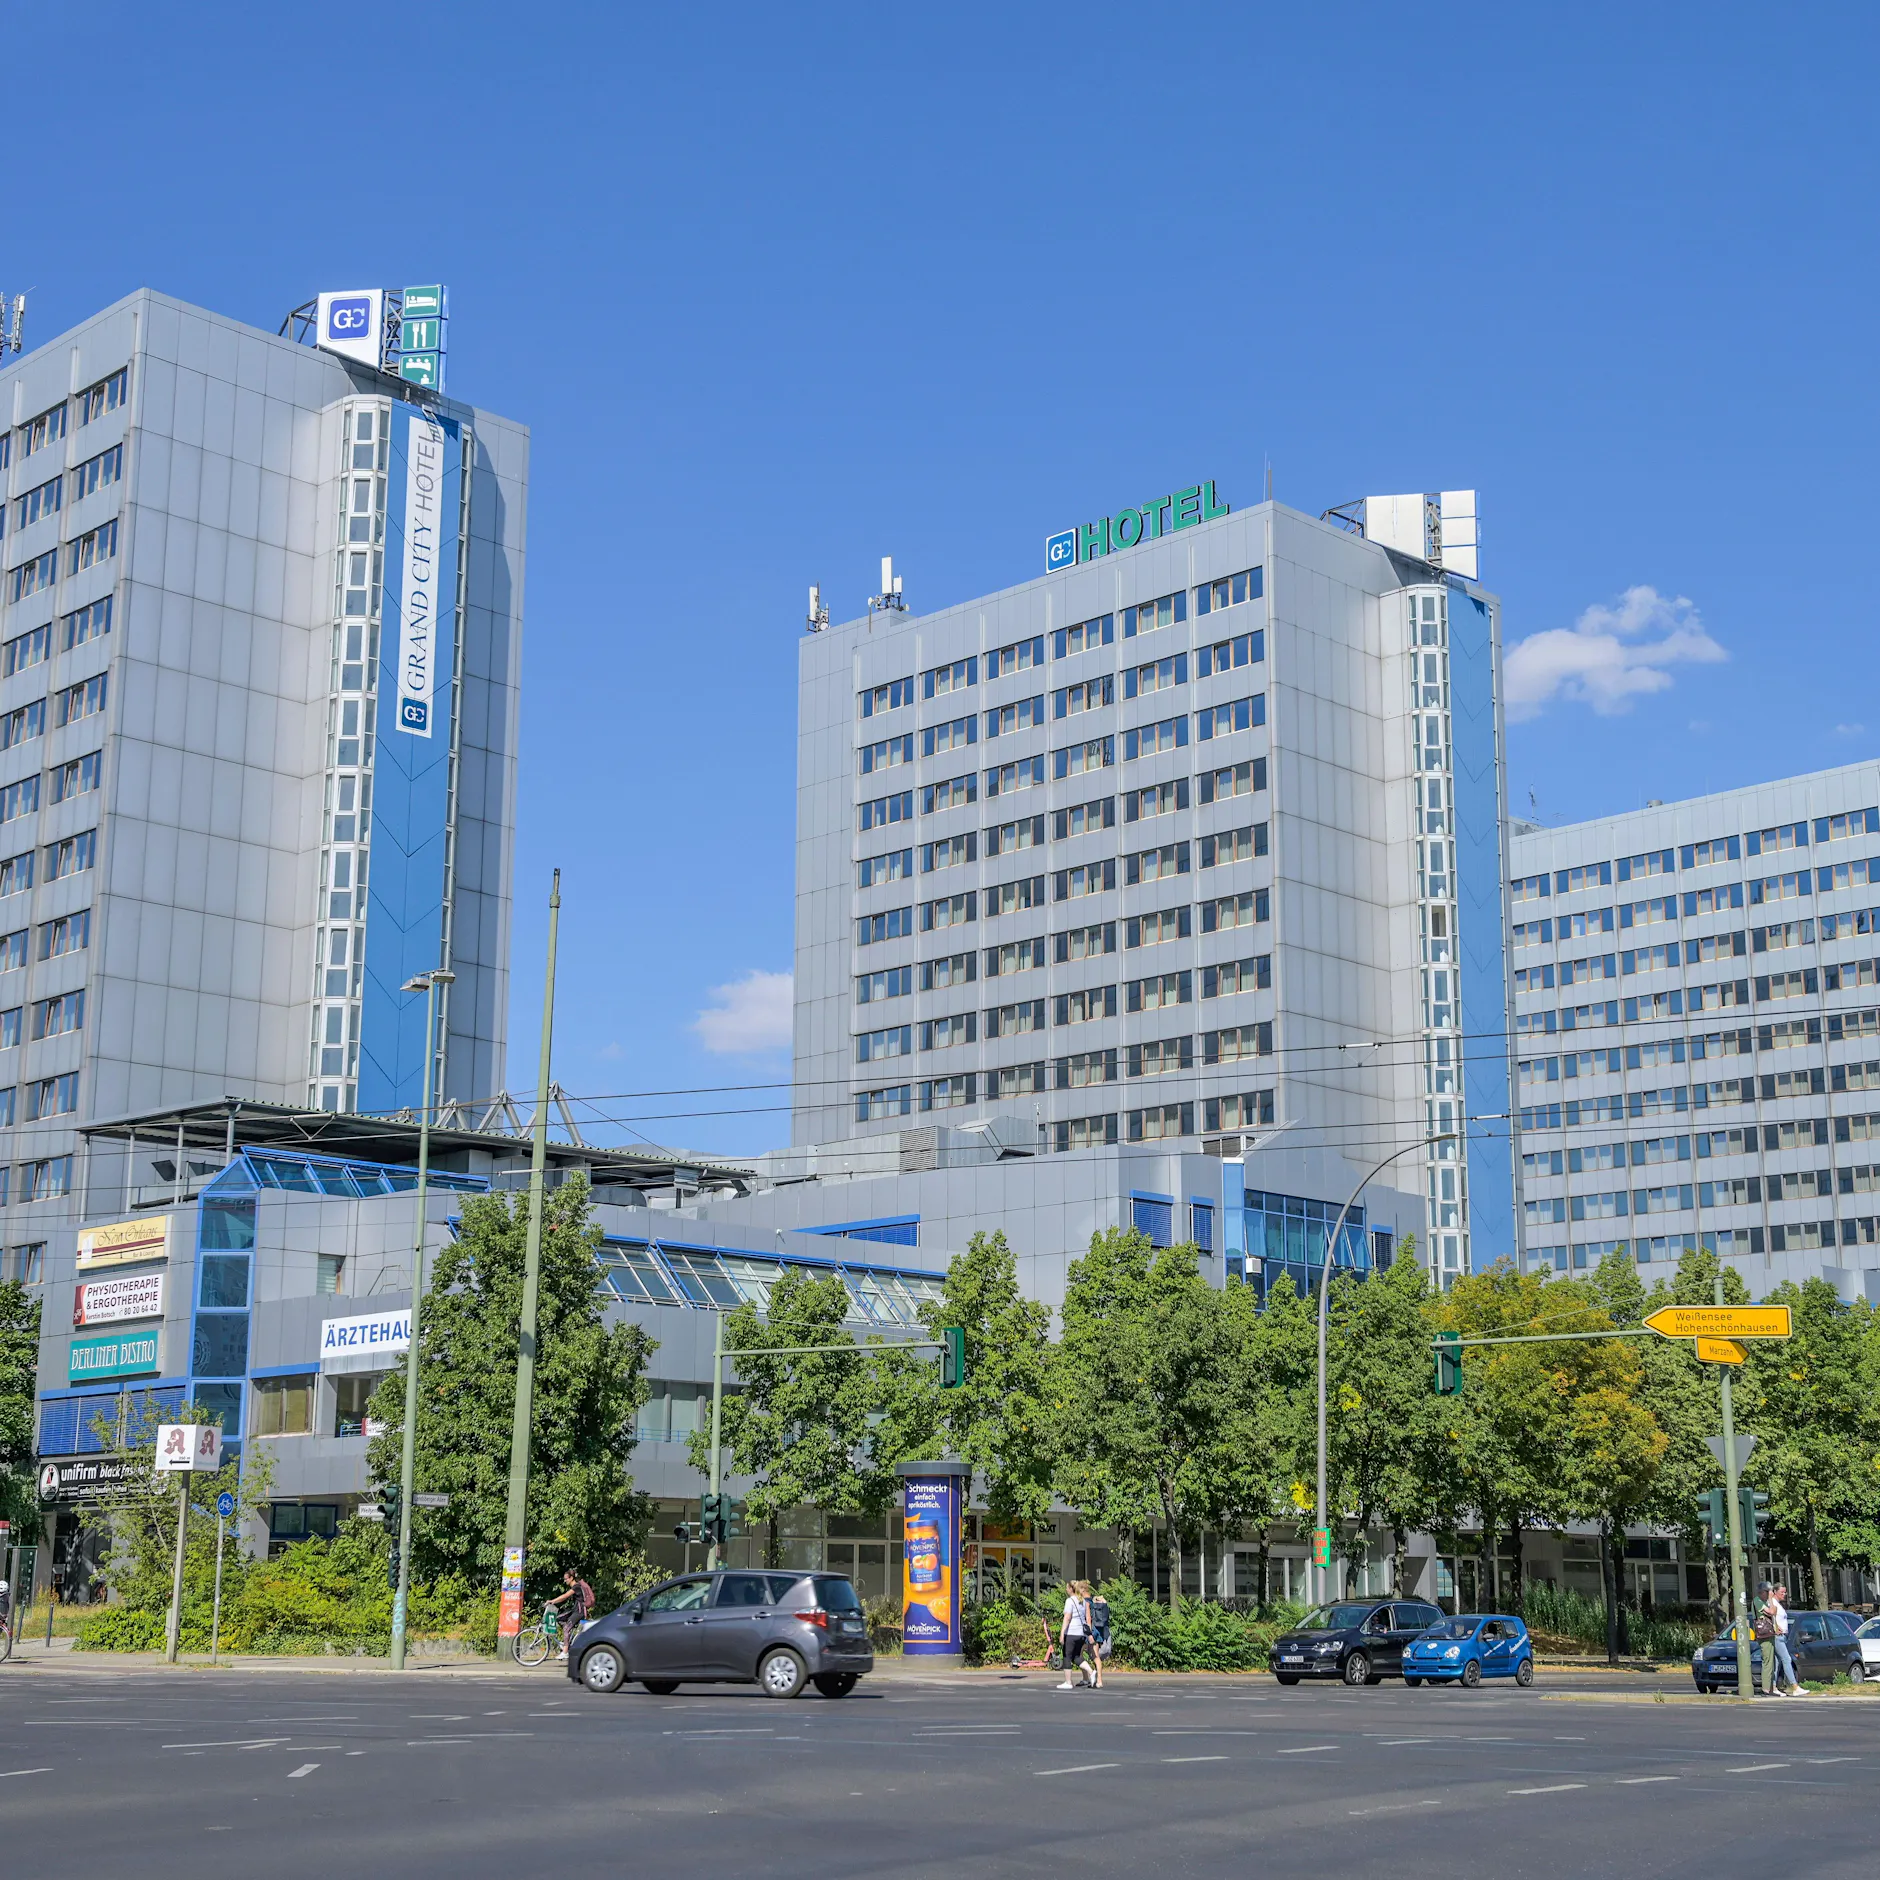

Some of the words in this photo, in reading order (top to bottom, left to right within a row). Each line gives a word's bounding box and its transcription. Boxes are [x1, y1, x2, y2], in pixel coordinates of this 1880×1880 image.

[415, 434, 437, 512] HOTEL
[1079, 480, 1230, 564] HOTEL
[411, 516, 432, 583] CITY
[407, 590, 429, 692] GRAND
[97, 1228, 123, 1246] New
[125, 1224, 158, 1242] Orleans
[87, 1277, 159, 1297] PHYSIOTHERAPIE
[86, 1301, 92, 1310] &
[93, 1291, 158, 1309] ERGOTHERAPIE
[124, 1308, 131, 1316] 80
[132, 1306, 140, 1314] 20
[141, 1305, 148, 1313] 64
[150, 1303, 158, 1312] 42
[1675, 1312, 1733, 1321] Weißensee
[325, 1319, 411, 1348] ÄRZTEHAU
[1675, 1323, 1779, 1333] Hohenschönhausen
[71, 1344, 118, 1370] BERLINER
[119, 1339, 155, 1365] BISTRO
[1709, 1345, 1734, 1357] Marzahn
[61, 1463, 97, 1481] unifirm
[99, 1463, 122, 1478] black
[909, 1483, 948, 1493] Schmeckt
[908, 1501, 941, 1510] apriköstlich.
[906, 1624, 941, 1633] MÖVENPICK
